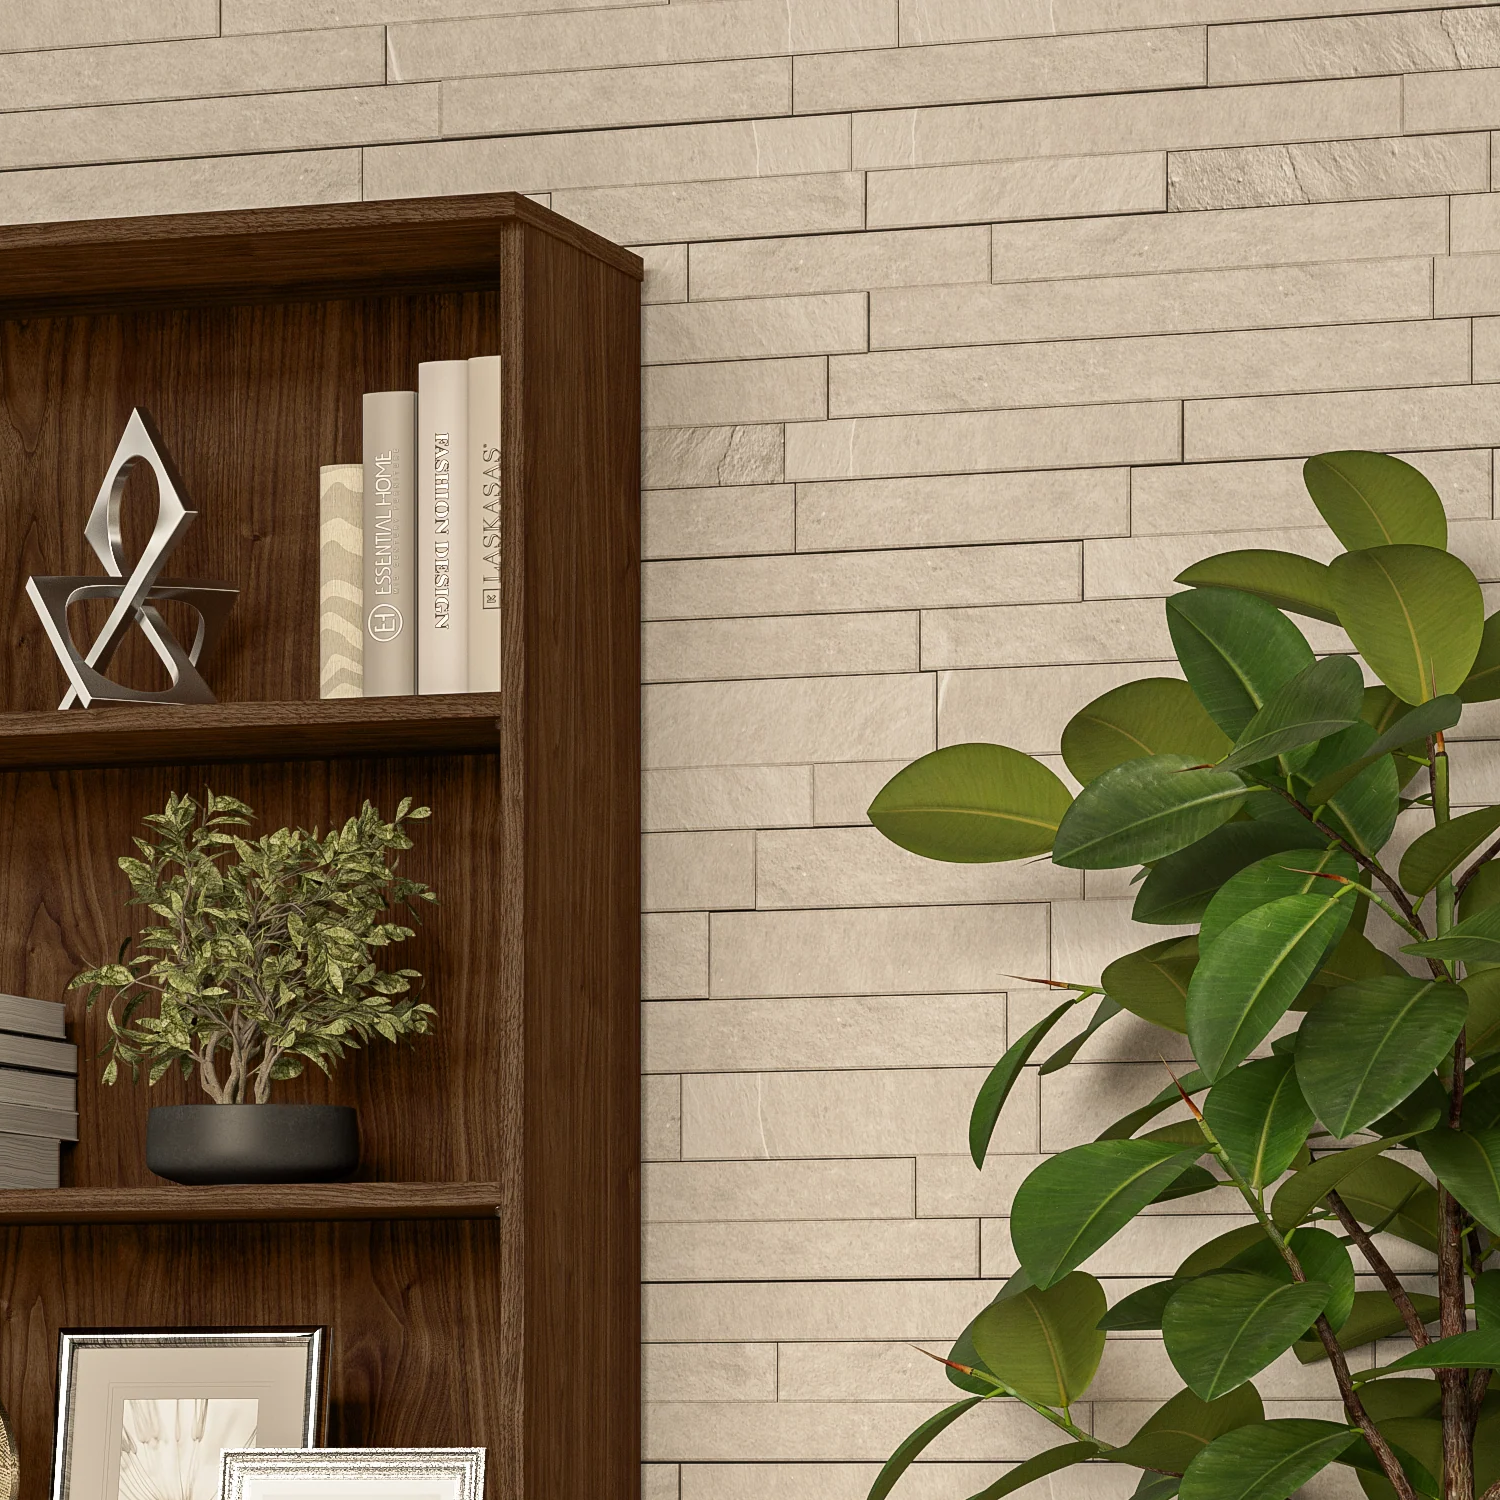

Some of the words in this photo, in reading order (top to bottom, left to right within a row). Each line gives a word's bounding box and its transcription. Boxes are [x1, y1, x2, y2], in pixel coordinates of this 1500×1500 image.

[375, 450, 392, 506] HOME
[434, 432, 450, 535] FASHION
[375, 509, 392, 595] ESSENTIAL
[434, 540, 450, 630] DESIGN
